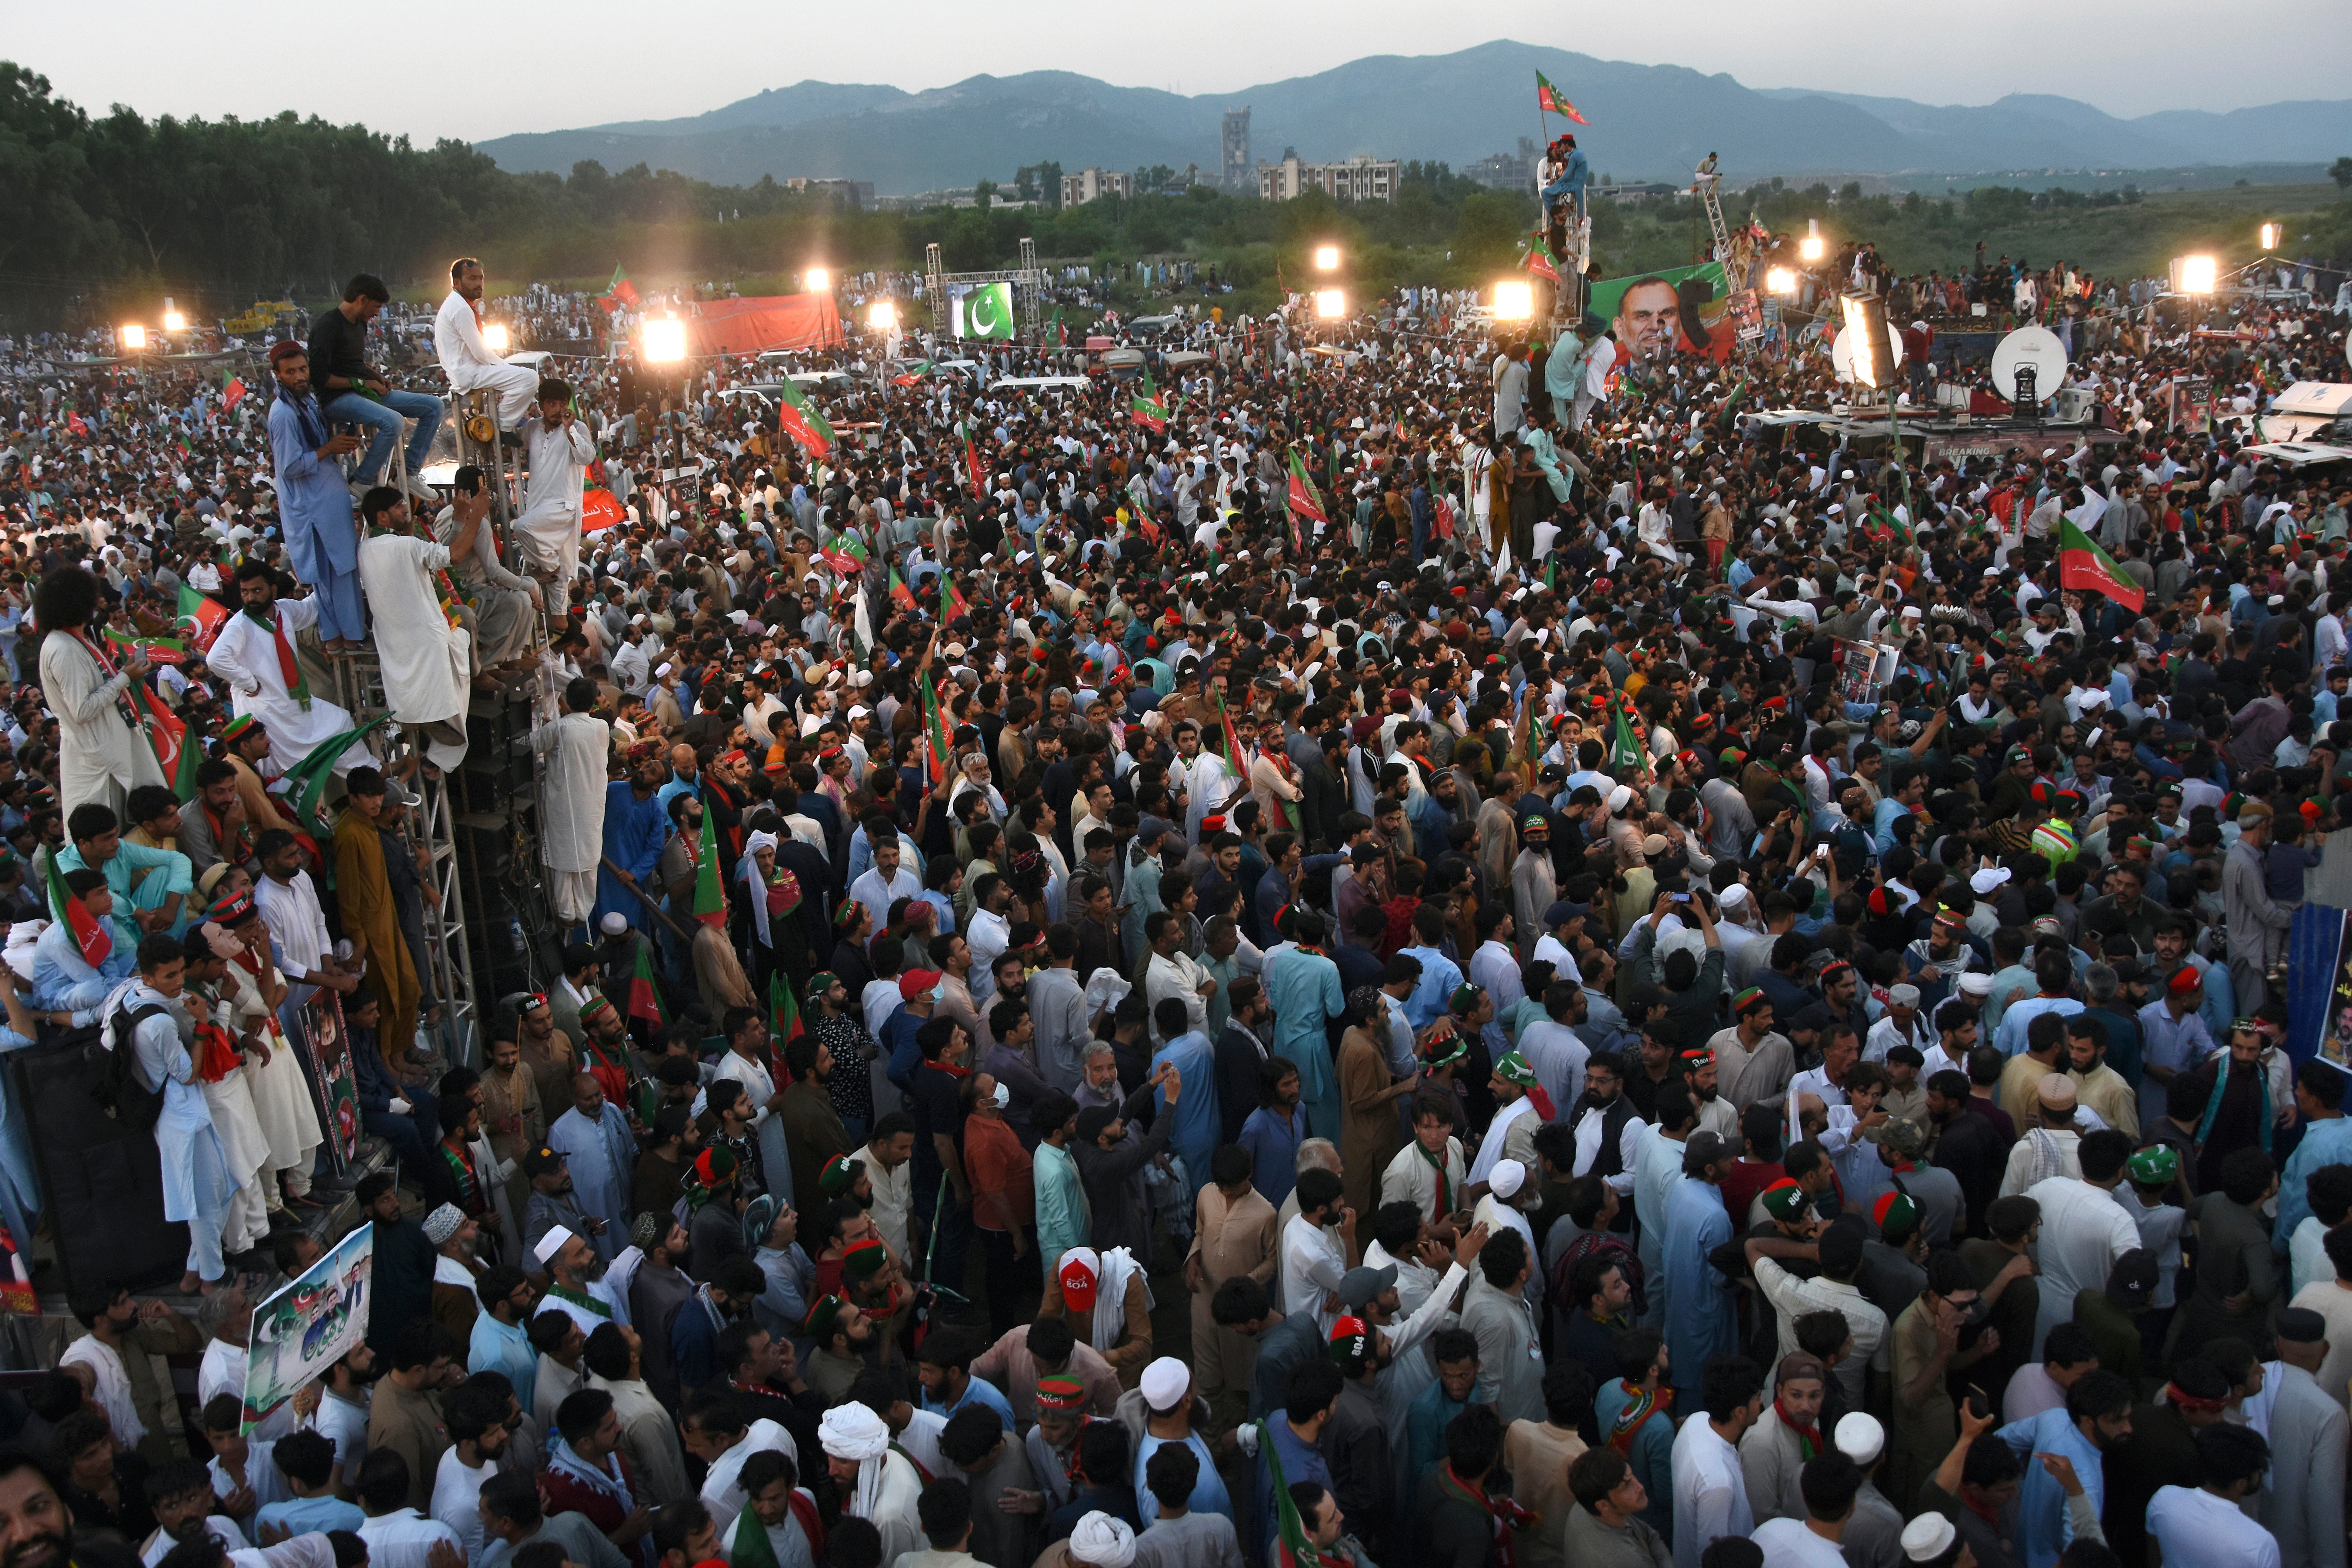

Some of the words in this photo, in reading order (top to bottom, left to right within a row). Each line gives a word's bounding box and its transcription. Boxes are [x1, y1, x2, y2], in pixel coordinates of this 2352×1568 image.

[801, 398, 814, 413] PTI
[1145, 404, 1158, 413] PTI
[1939, 447, 1990, 456] BREAKING
[842, 537, 856, 550] PTI
[526, 998, 540, 1010] 804
[1788, 1188, 1802, 1206] 804
[1067, 1280, 1088, 1289] 804
[1351, 1336, 1364, 1355] 804
